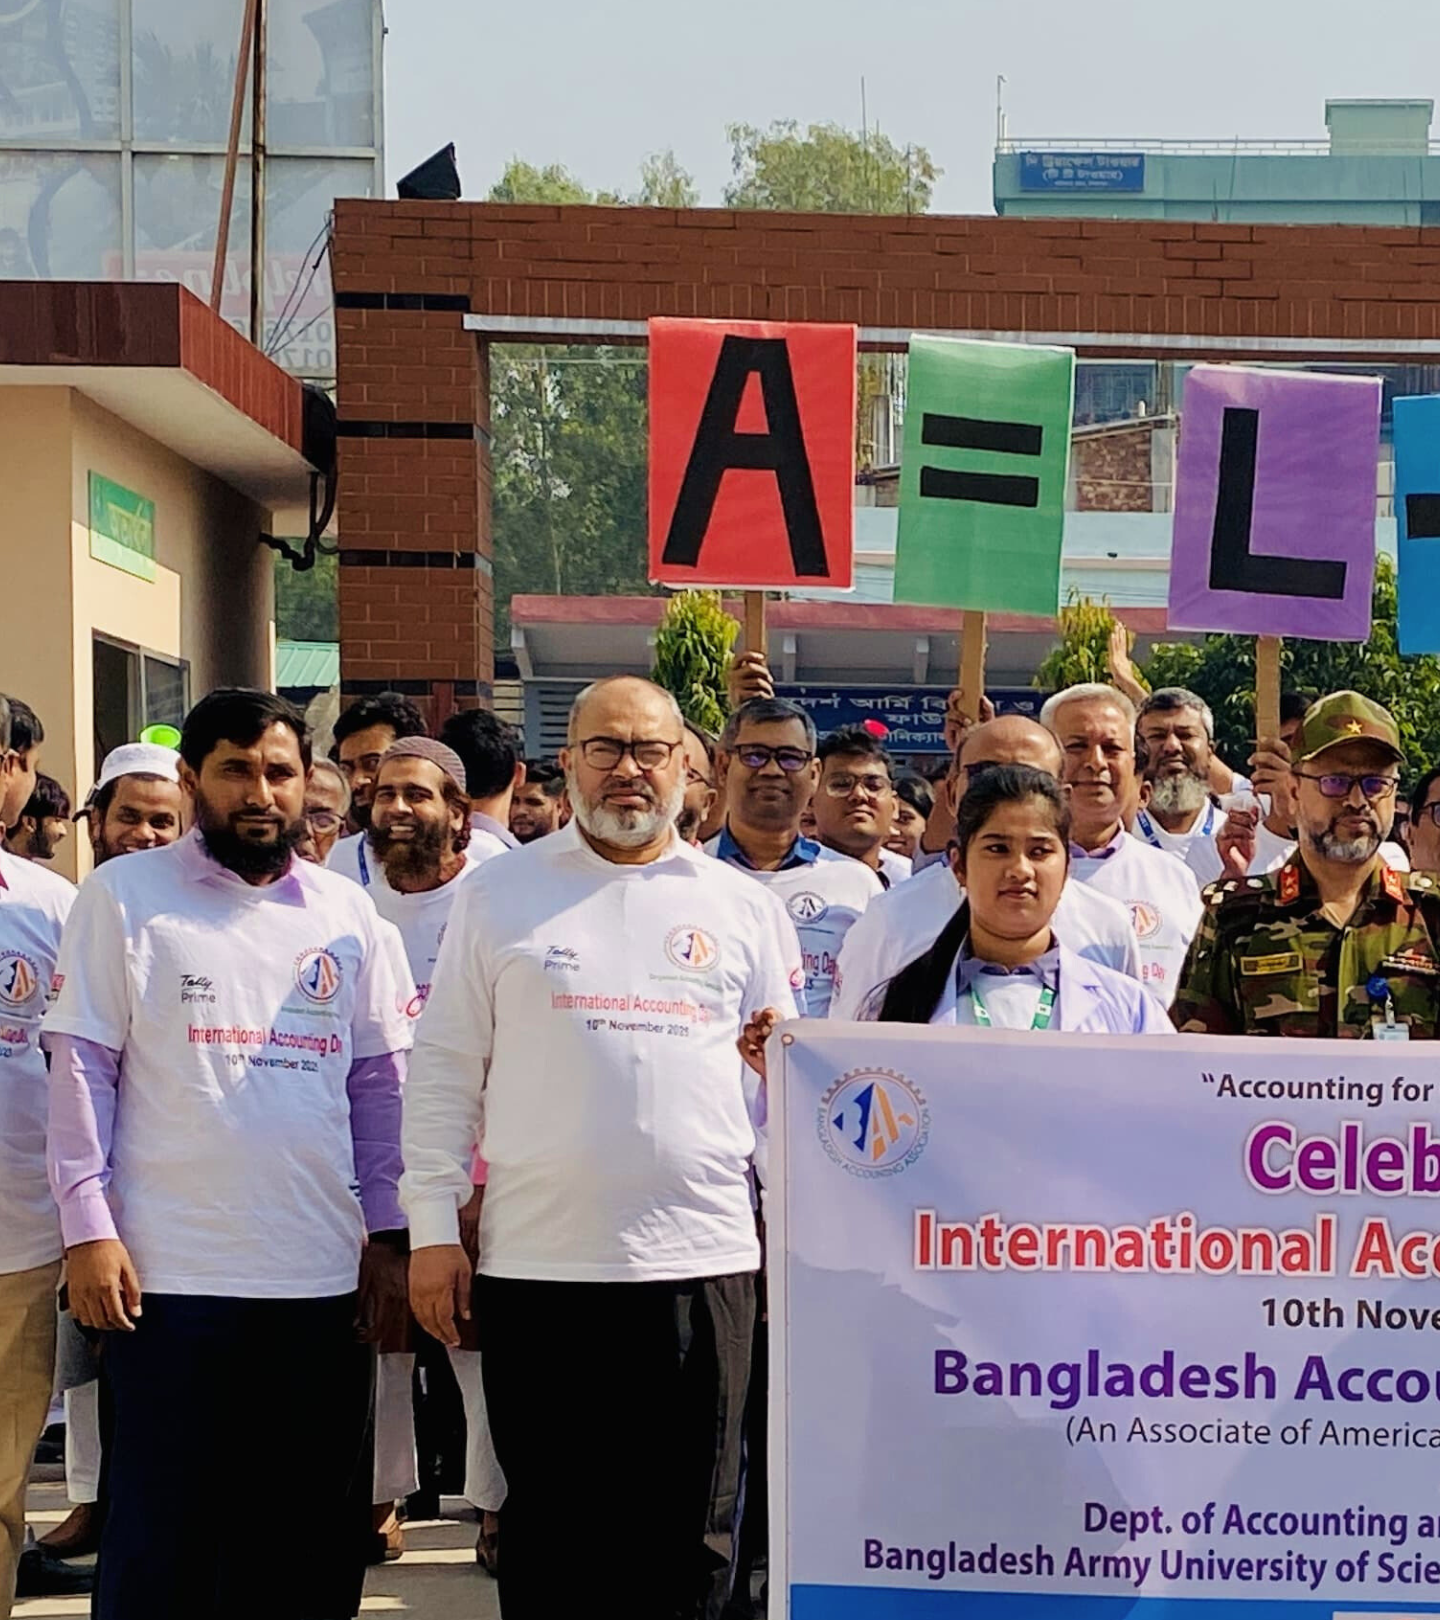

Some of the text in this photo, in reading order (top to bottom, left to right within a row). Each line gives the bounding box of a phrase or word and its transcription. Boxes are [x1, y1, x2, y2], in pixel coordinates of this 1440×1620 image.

[661, 333, 831, 578] A
[1208, 406, 1348, 600] L
[544, 960, 580, 971] Prime
[181, 992, 216, 1004] Prime
[551, 991, 630, 1011] International
[634, 995, 697, 1023] Accounting
[188, 1024, 266, 1045] International
[269, 1029, 327, 1057] Accounting
[609, 1019, 663, 1034] November
[248, 1055, 299, 1070] November
[1202, 1072, 1384, 1108] “Accounting
[1391, 1076, 1434, 1102] for
[916, 1212, 1334, 1274] International
[1262, 1298, 1344, 1329] 10th
[934, 1349, 1276, 1410] Bangladesh
[1065, 1416, 1117, 1448] (An
[1126, 1417, 1271, 1446] Associate
[1280, 1418, 1314, 1446] of
[1084, 1502, 1173, 1541] Dept.
[1182, 1504, 1215, 1535] of
[1222, 1505, 1409, 1545] Accounting
[864, 1539, 1055, 1580] Bangladesh
[1064, 1547, 1151, 1586] Army
[1160, 1549, 1325, 1590] University
[1335, 1551, 1371, 1584] of
